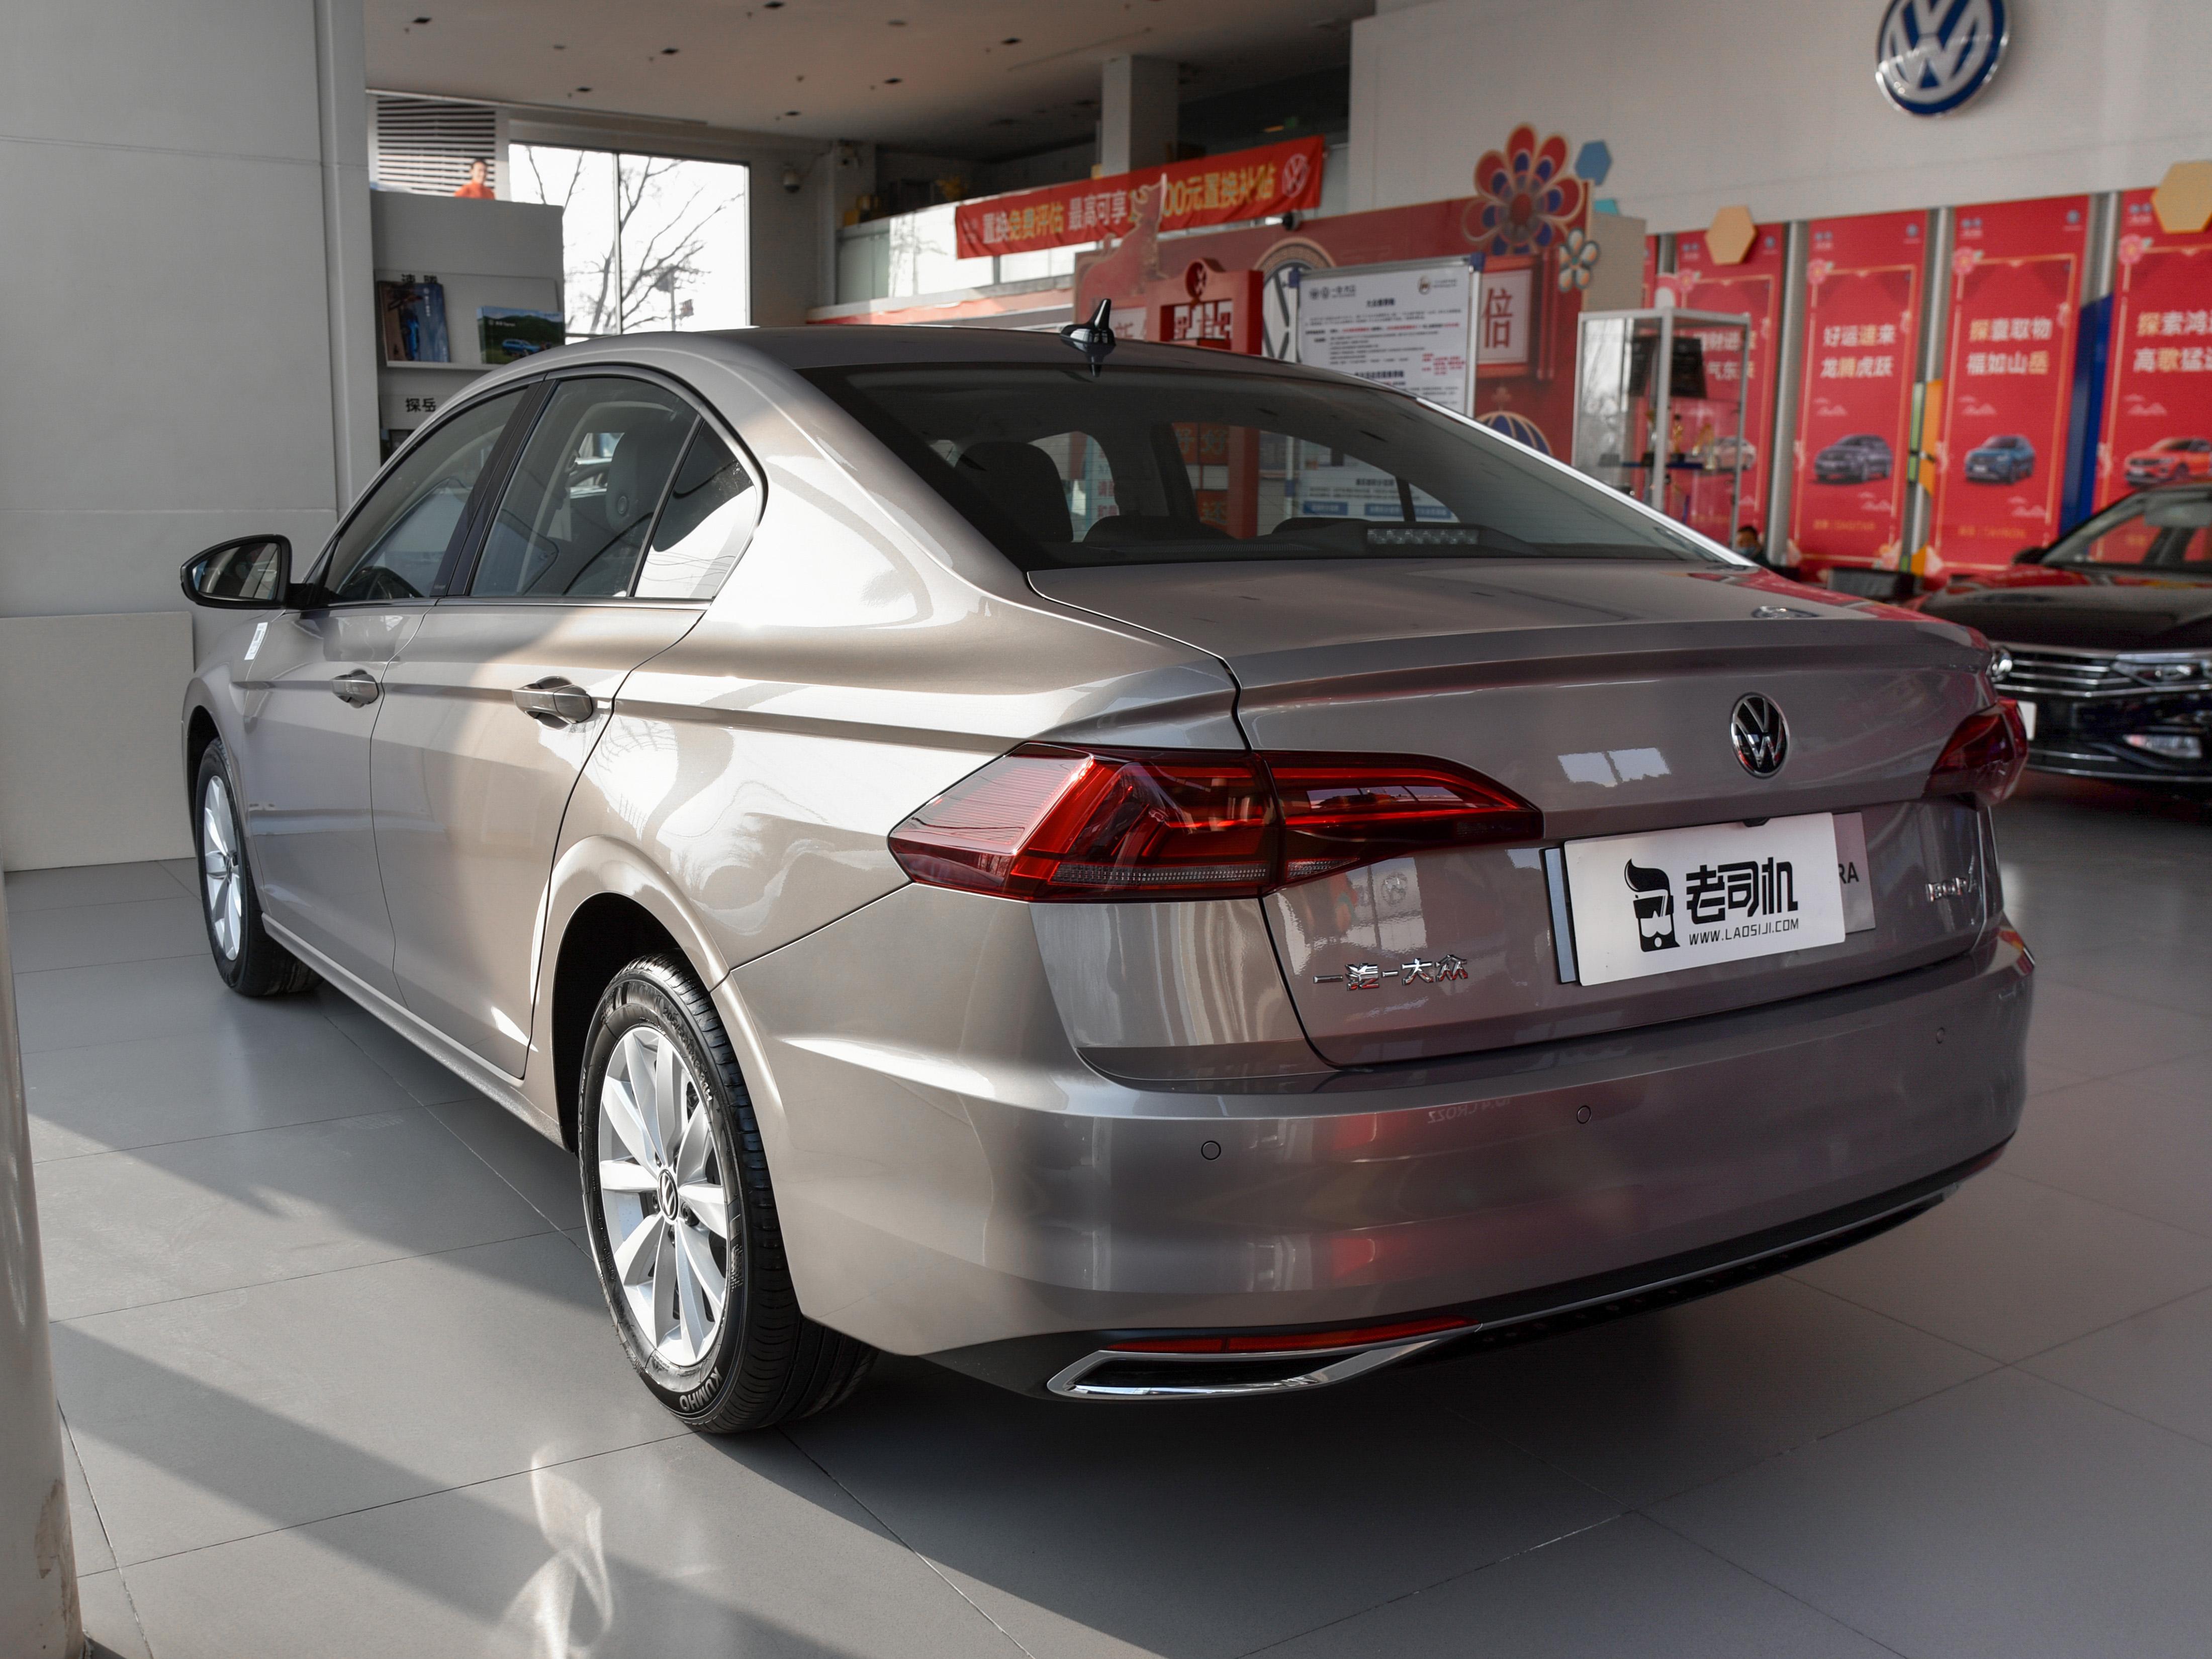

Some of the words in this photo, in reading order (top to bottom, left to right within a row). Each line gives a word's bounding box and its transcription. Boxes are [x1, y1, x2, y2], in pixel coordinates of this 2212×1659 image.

[1483, 288, 1512, 349] 倍
[2137, 309, 2212, 337] 探索鸿
[1822, 324, 1895, 347] 好运速来
[1820, 355, 1894, 378] 龙腾虎跃
[1967, 350, 2048, 375] 福如山岳
[405, 398, 436, 412] 探岳
[1686, 857, 1798, 925] 老司机
[1689, 918, 1799, 946] WWW.LAOSIJI.COM
[679, 1366, 723, 1412] KUMHO
